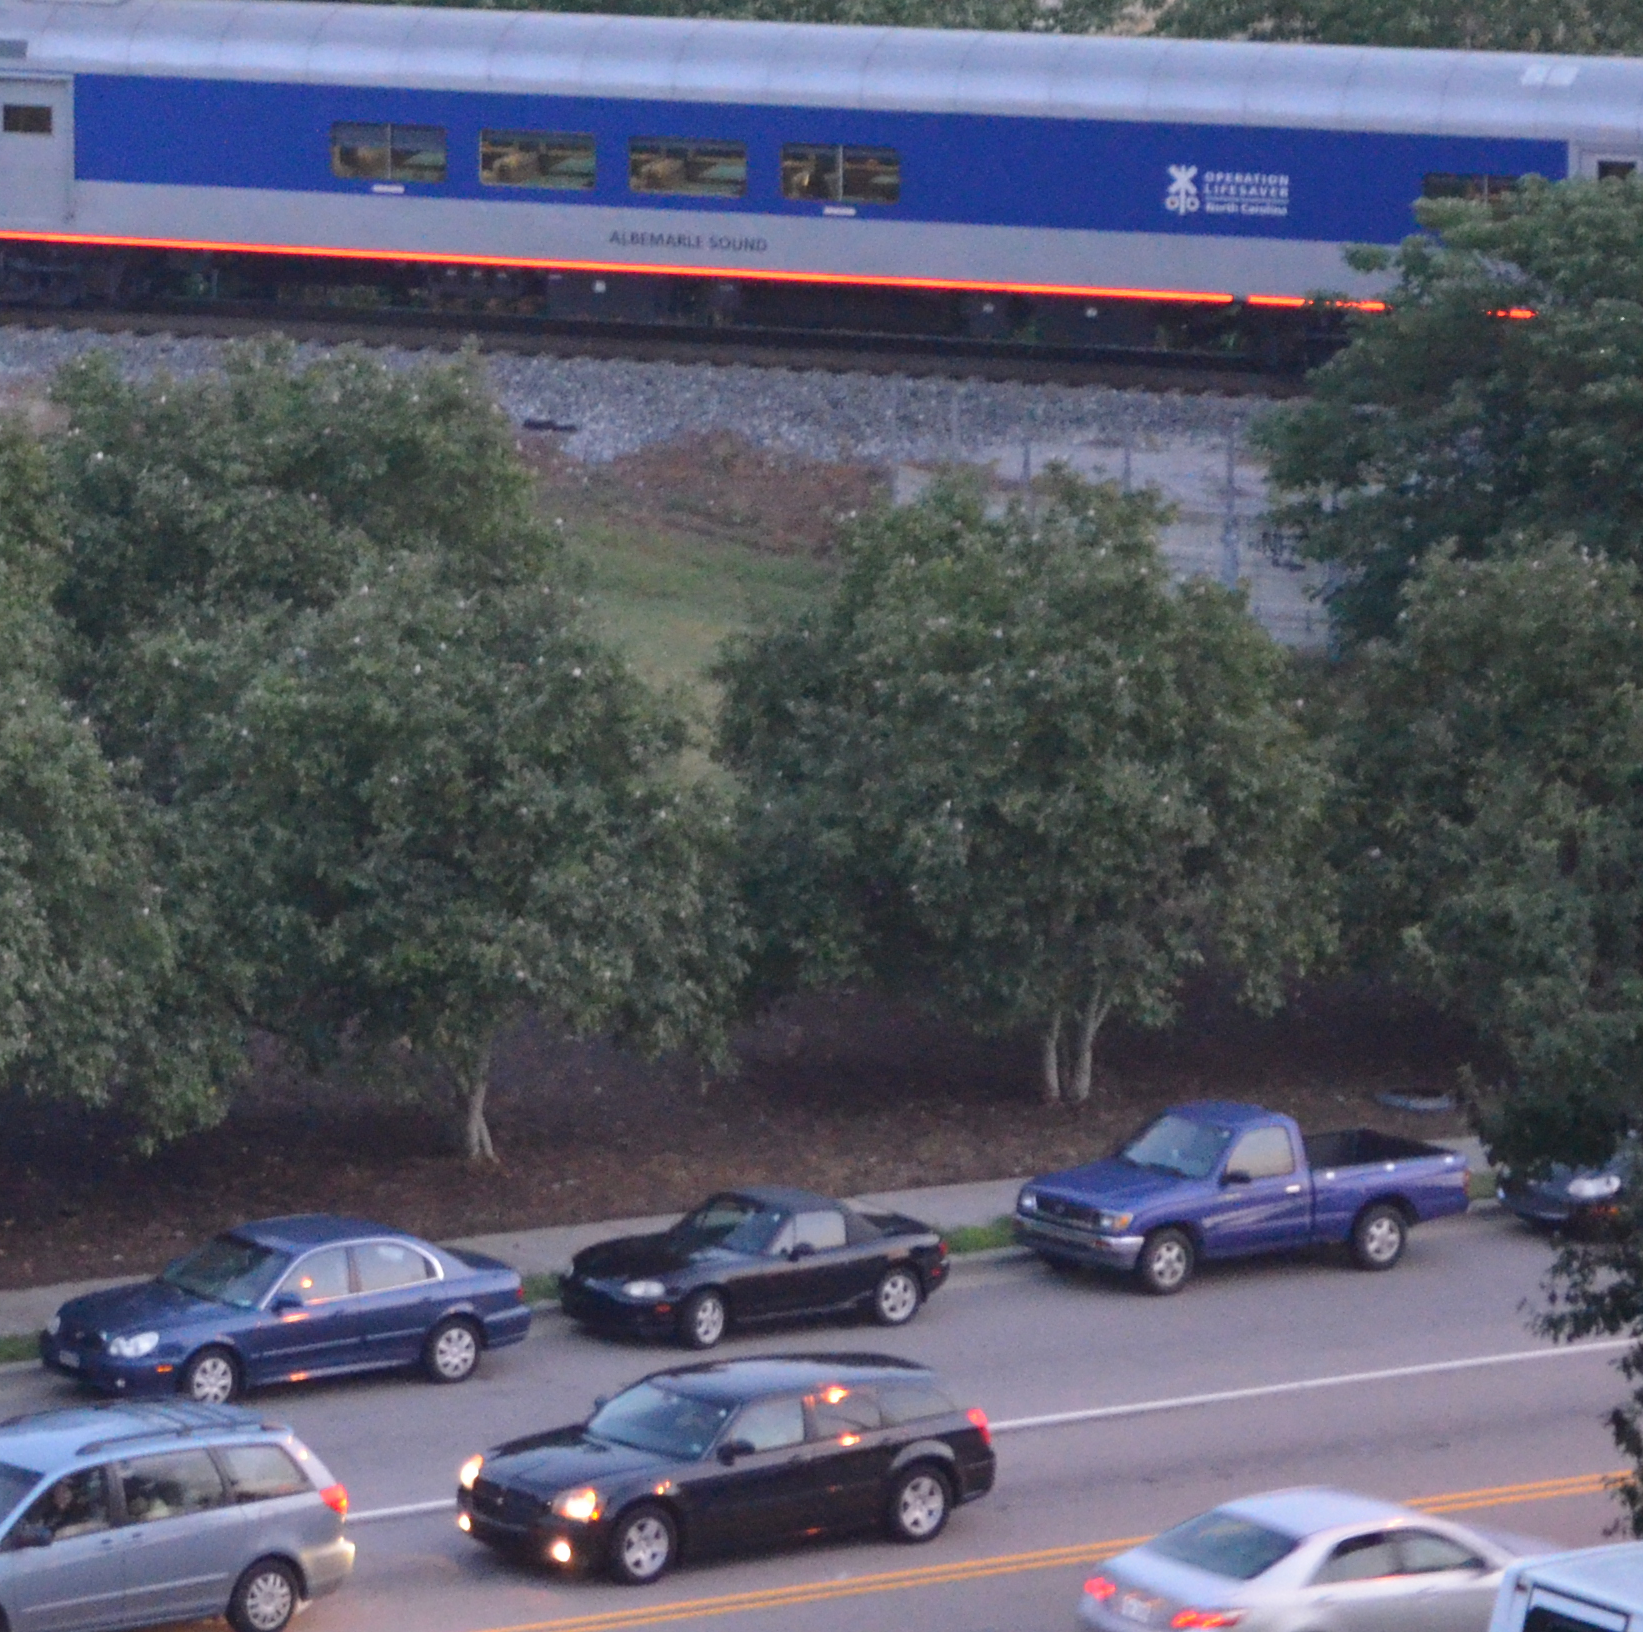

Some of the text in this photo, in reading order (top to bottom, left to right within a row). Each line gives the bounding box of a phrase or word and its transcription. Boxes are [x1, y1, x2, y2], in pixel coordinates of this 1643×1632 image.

[1204, 171, 1289, 186] OPERATION
[1204, 183, 1289, 198] LIFESAVER
[1205, 202, 1288, 216] North Carolina
[609, 230, 768, 252] ALBEMARLE SOUND
